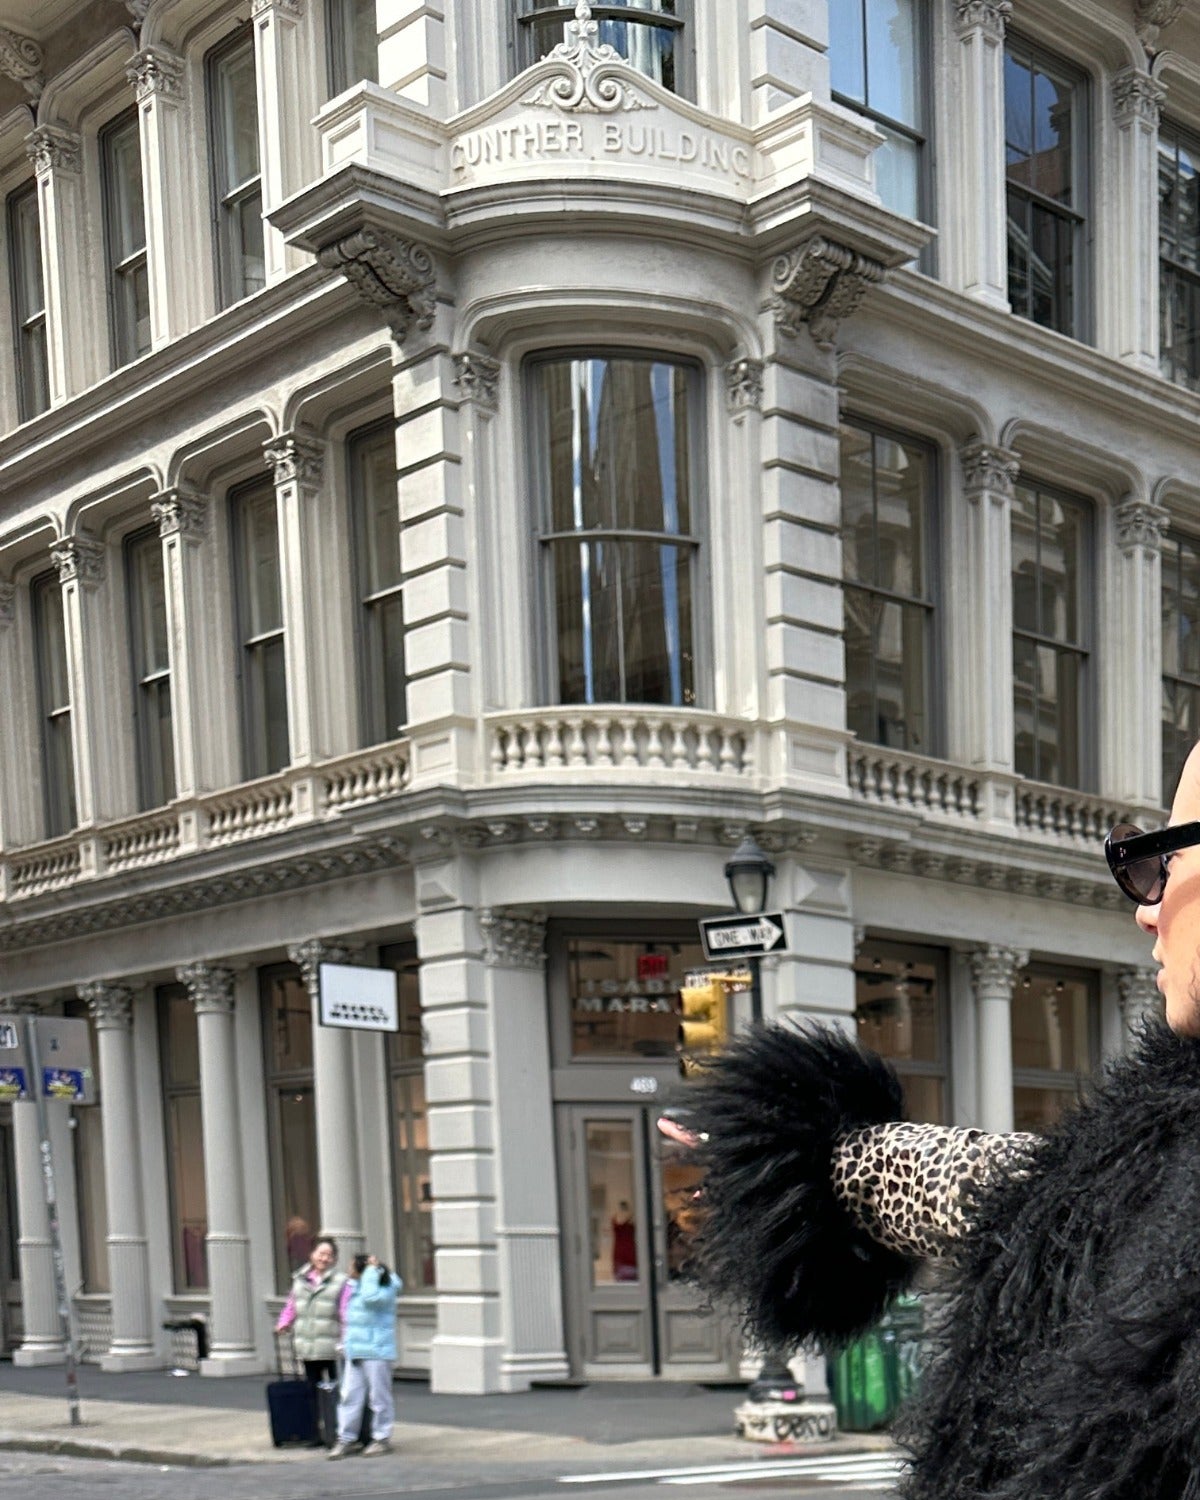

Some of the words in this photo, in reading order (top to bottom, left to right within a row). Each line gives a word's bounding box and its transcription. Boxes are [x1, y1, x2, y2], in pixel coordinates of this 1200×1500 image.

[450, 120, 584, 171] GUNTHER
[603, 121, 750, 178] BUILDING
[714, 929, 741, 946] ONE
[748, 925, 774, 942] WAY
[577, 998, 671, 1013] MARA
